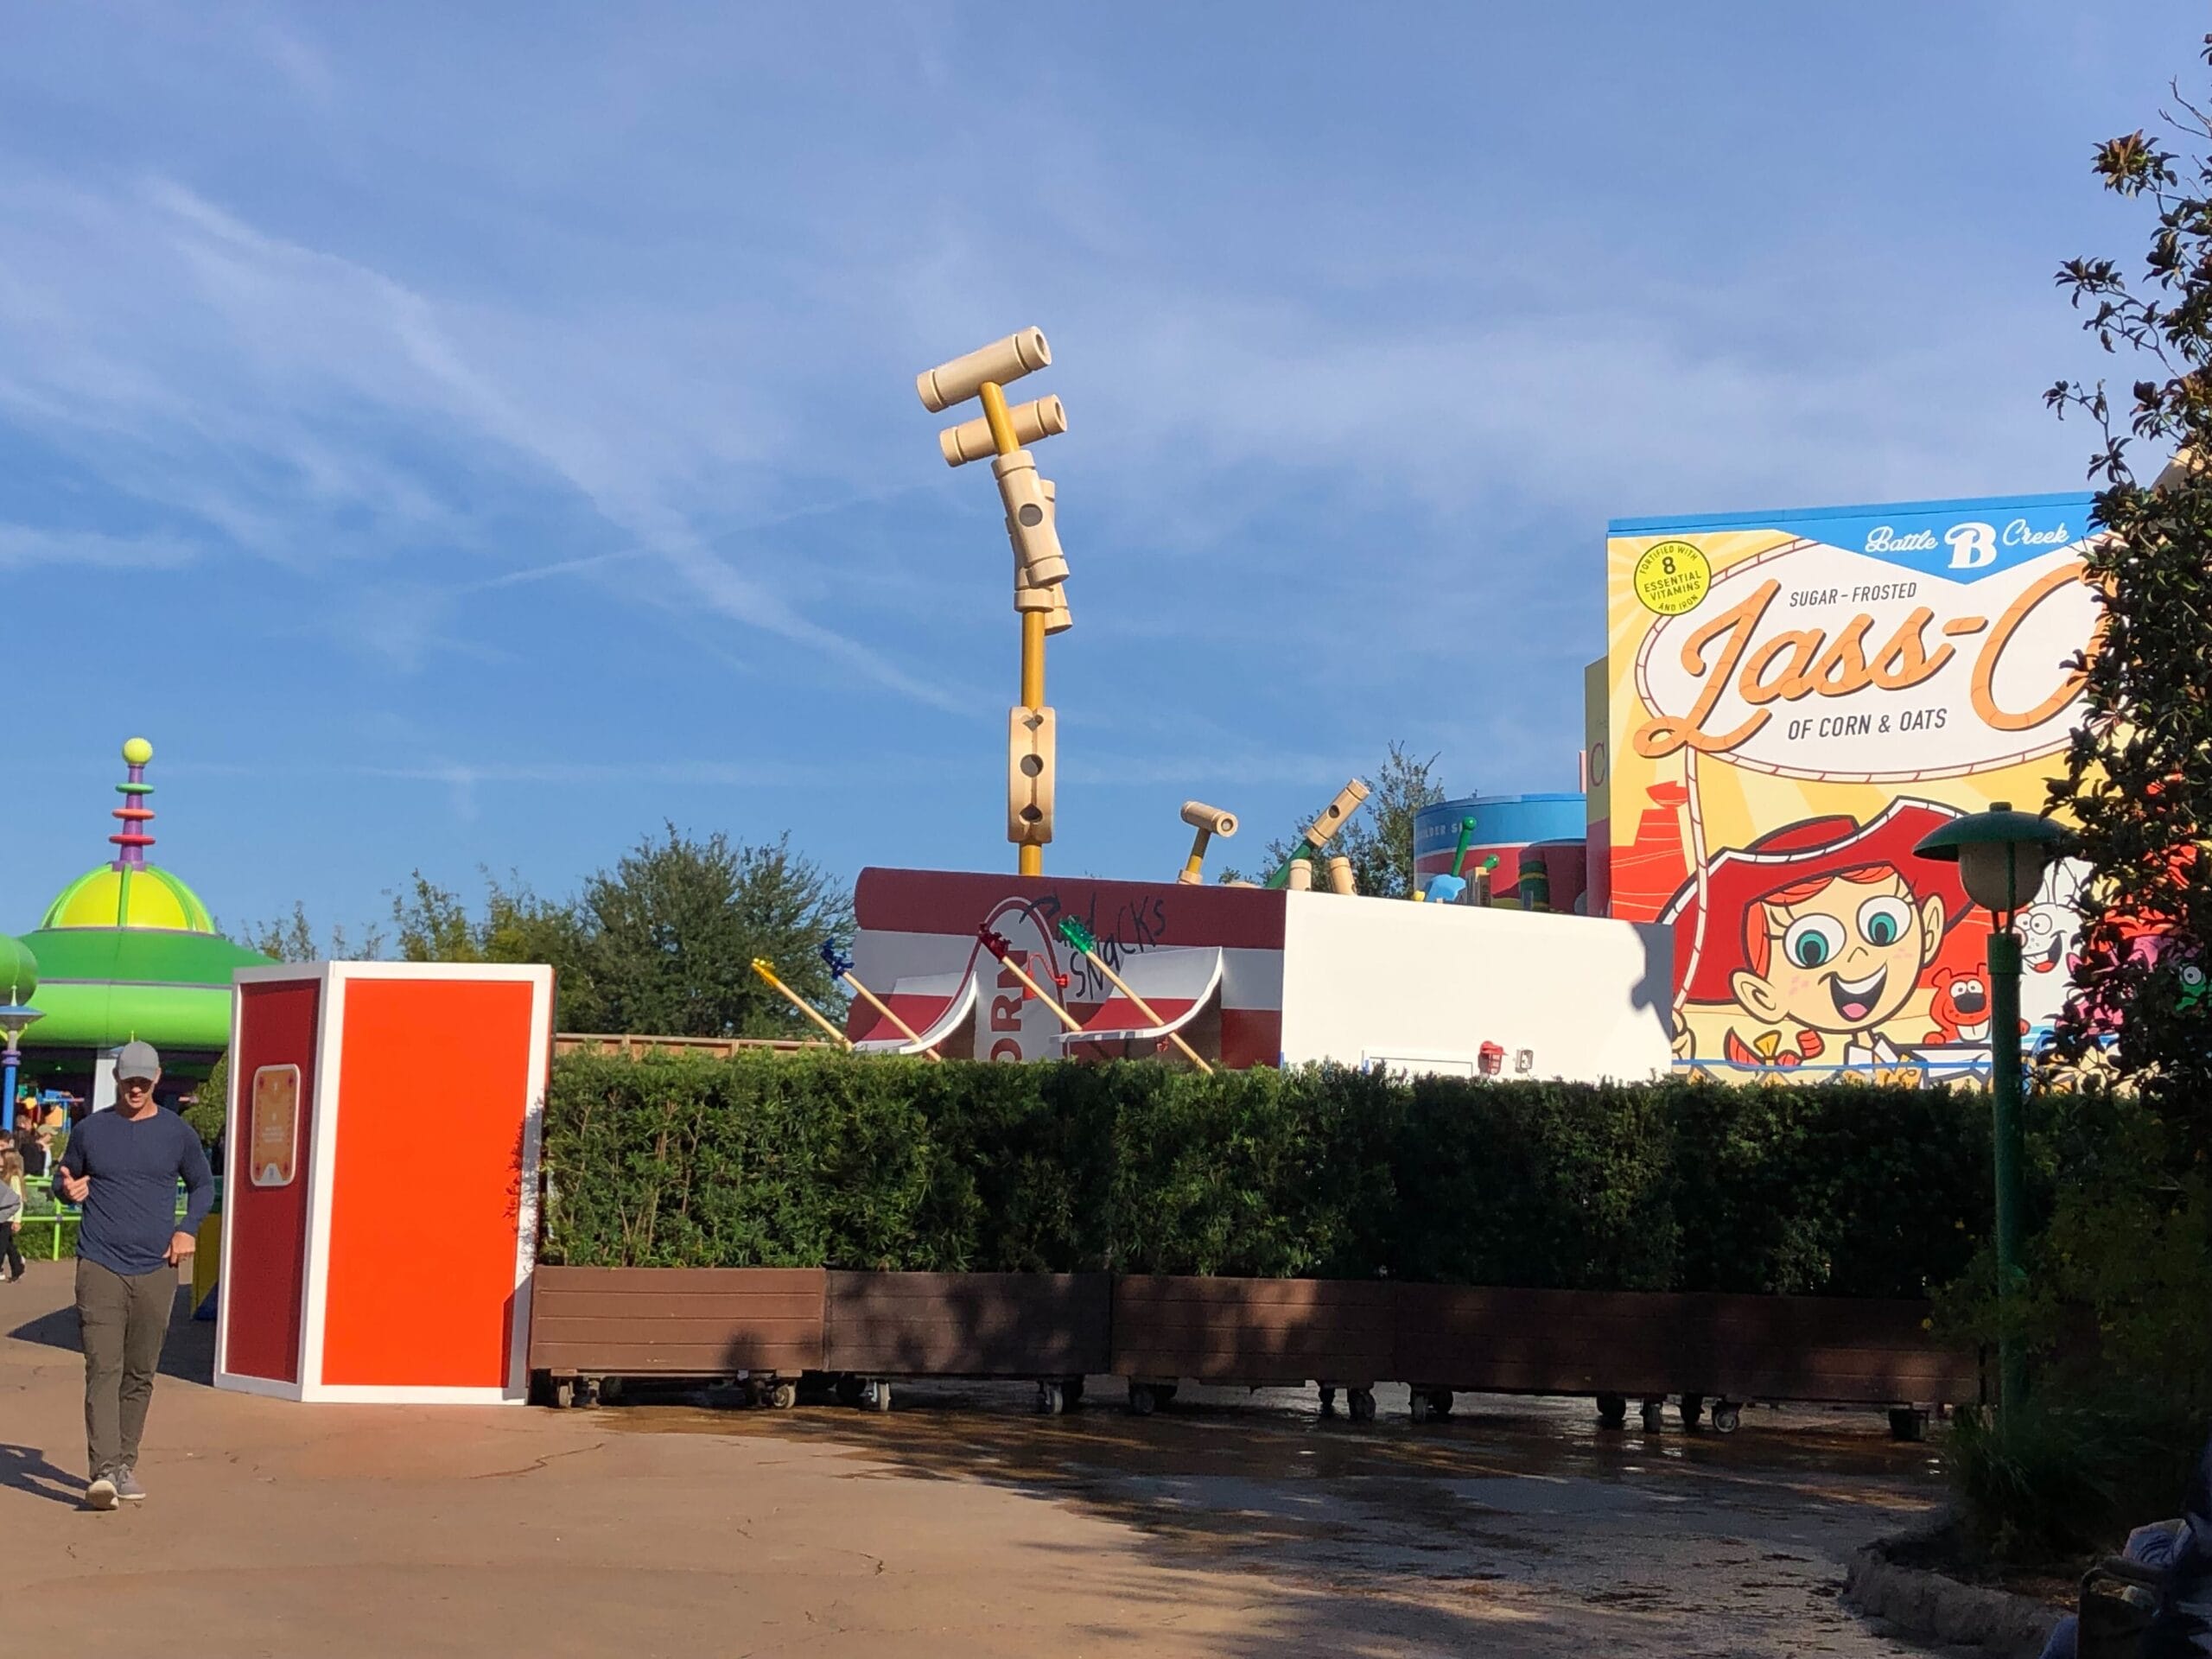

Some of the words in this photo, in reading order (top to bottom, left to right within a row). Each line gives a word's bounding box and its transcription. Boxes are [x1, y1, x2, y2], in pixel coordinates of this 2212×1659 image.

[1865, 525, 1938, 553] Battle
[1944, 522, 1997, 569] B
[2002, 518, 2069, 546] Creek
[1639, 545, 1674, 575] FORTIFIED
[1677, 546, 1698, 561] WITH
[1662, 556, 1676, 575] 8
[1643, 570, 1701, 593] ESSENTIAL
[1649, 581, 1700, 601] VITAMINS
[1658, 602, 1676, 611] AND
[1678, 594, 1699, 610] IRON
[1788, 719, 1814, 741] OF
[1818, 714, 1872, 738] CORN
[1878, 715, 1891, 734] &
[1899, 708, 1948, 732] OATS
